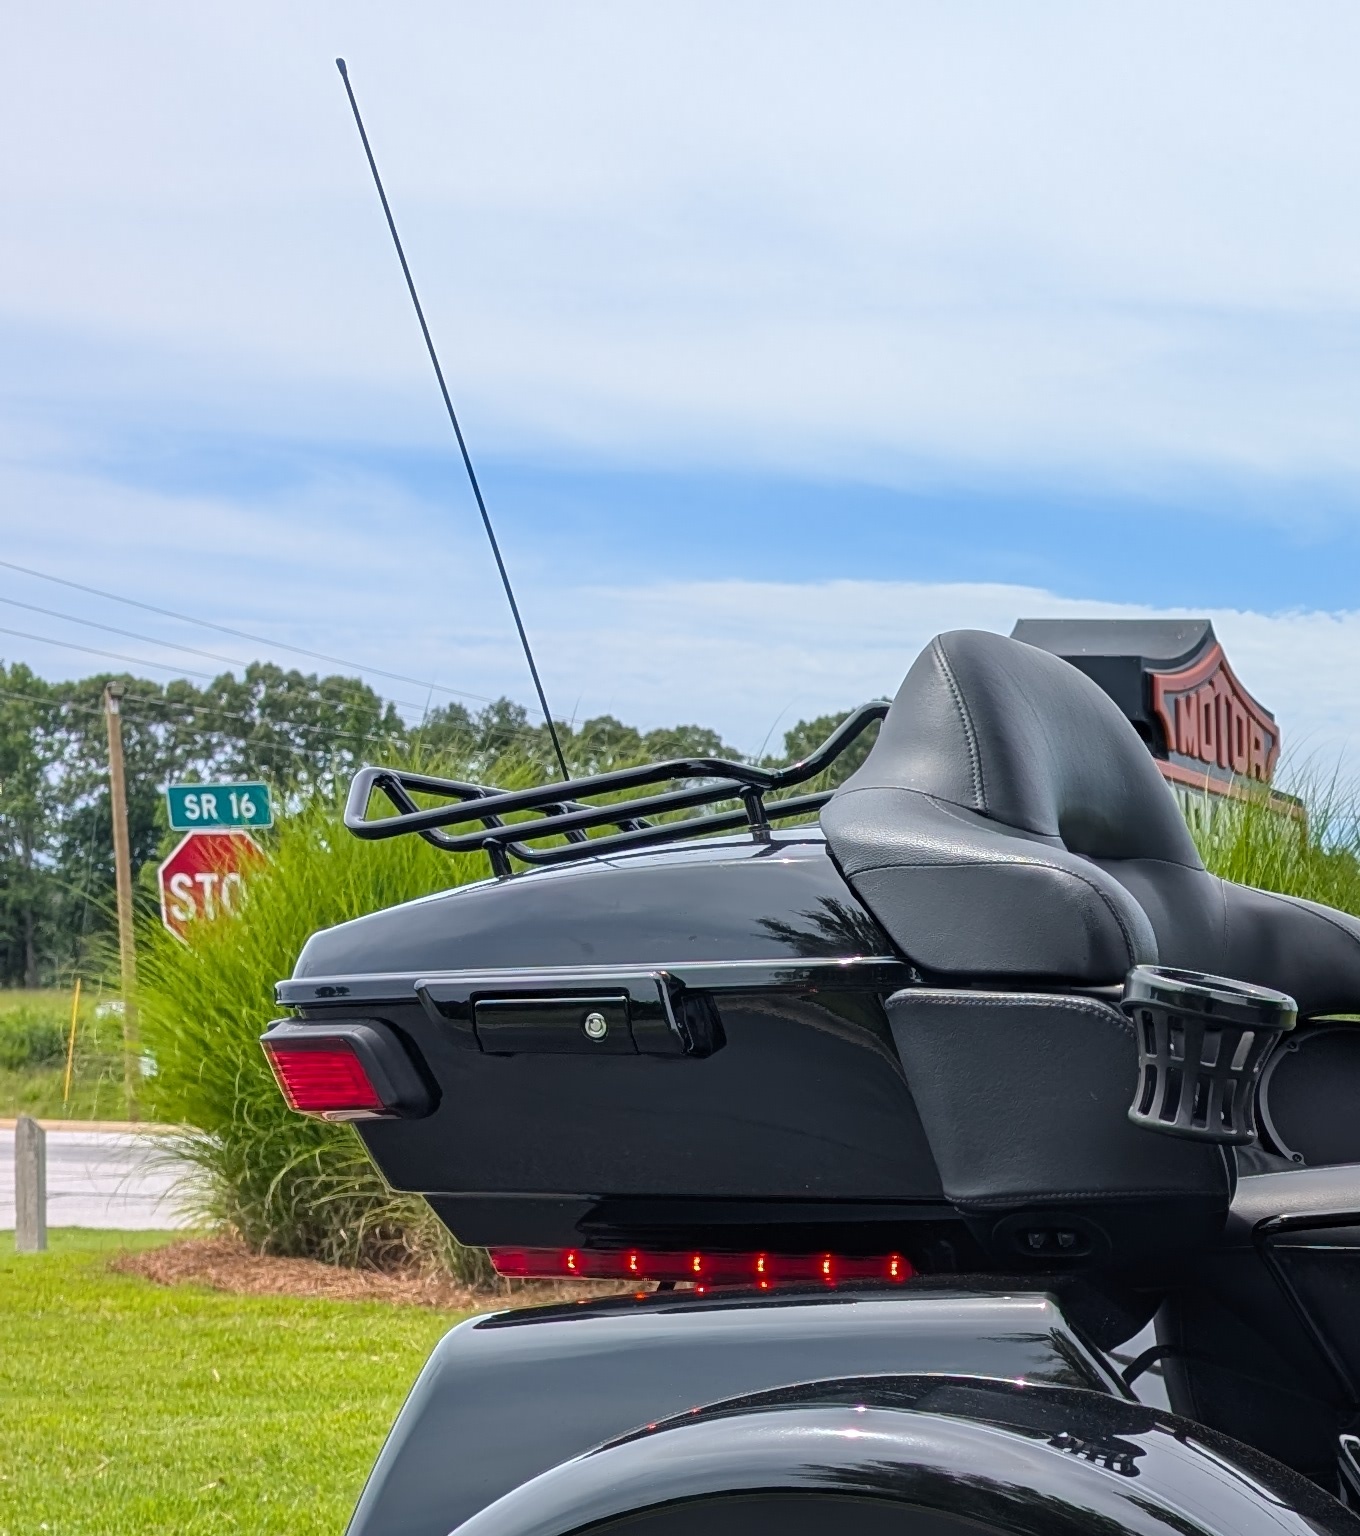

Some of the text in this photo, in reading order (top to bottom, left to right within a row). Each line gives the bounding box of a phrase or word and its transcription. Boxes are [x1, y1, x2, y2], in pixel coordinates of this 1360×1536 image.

[1174, 661, 1266, 783] MOTOR
[184, 792, 257, 820] SR 16
[170, 872, 256, 922] STO
